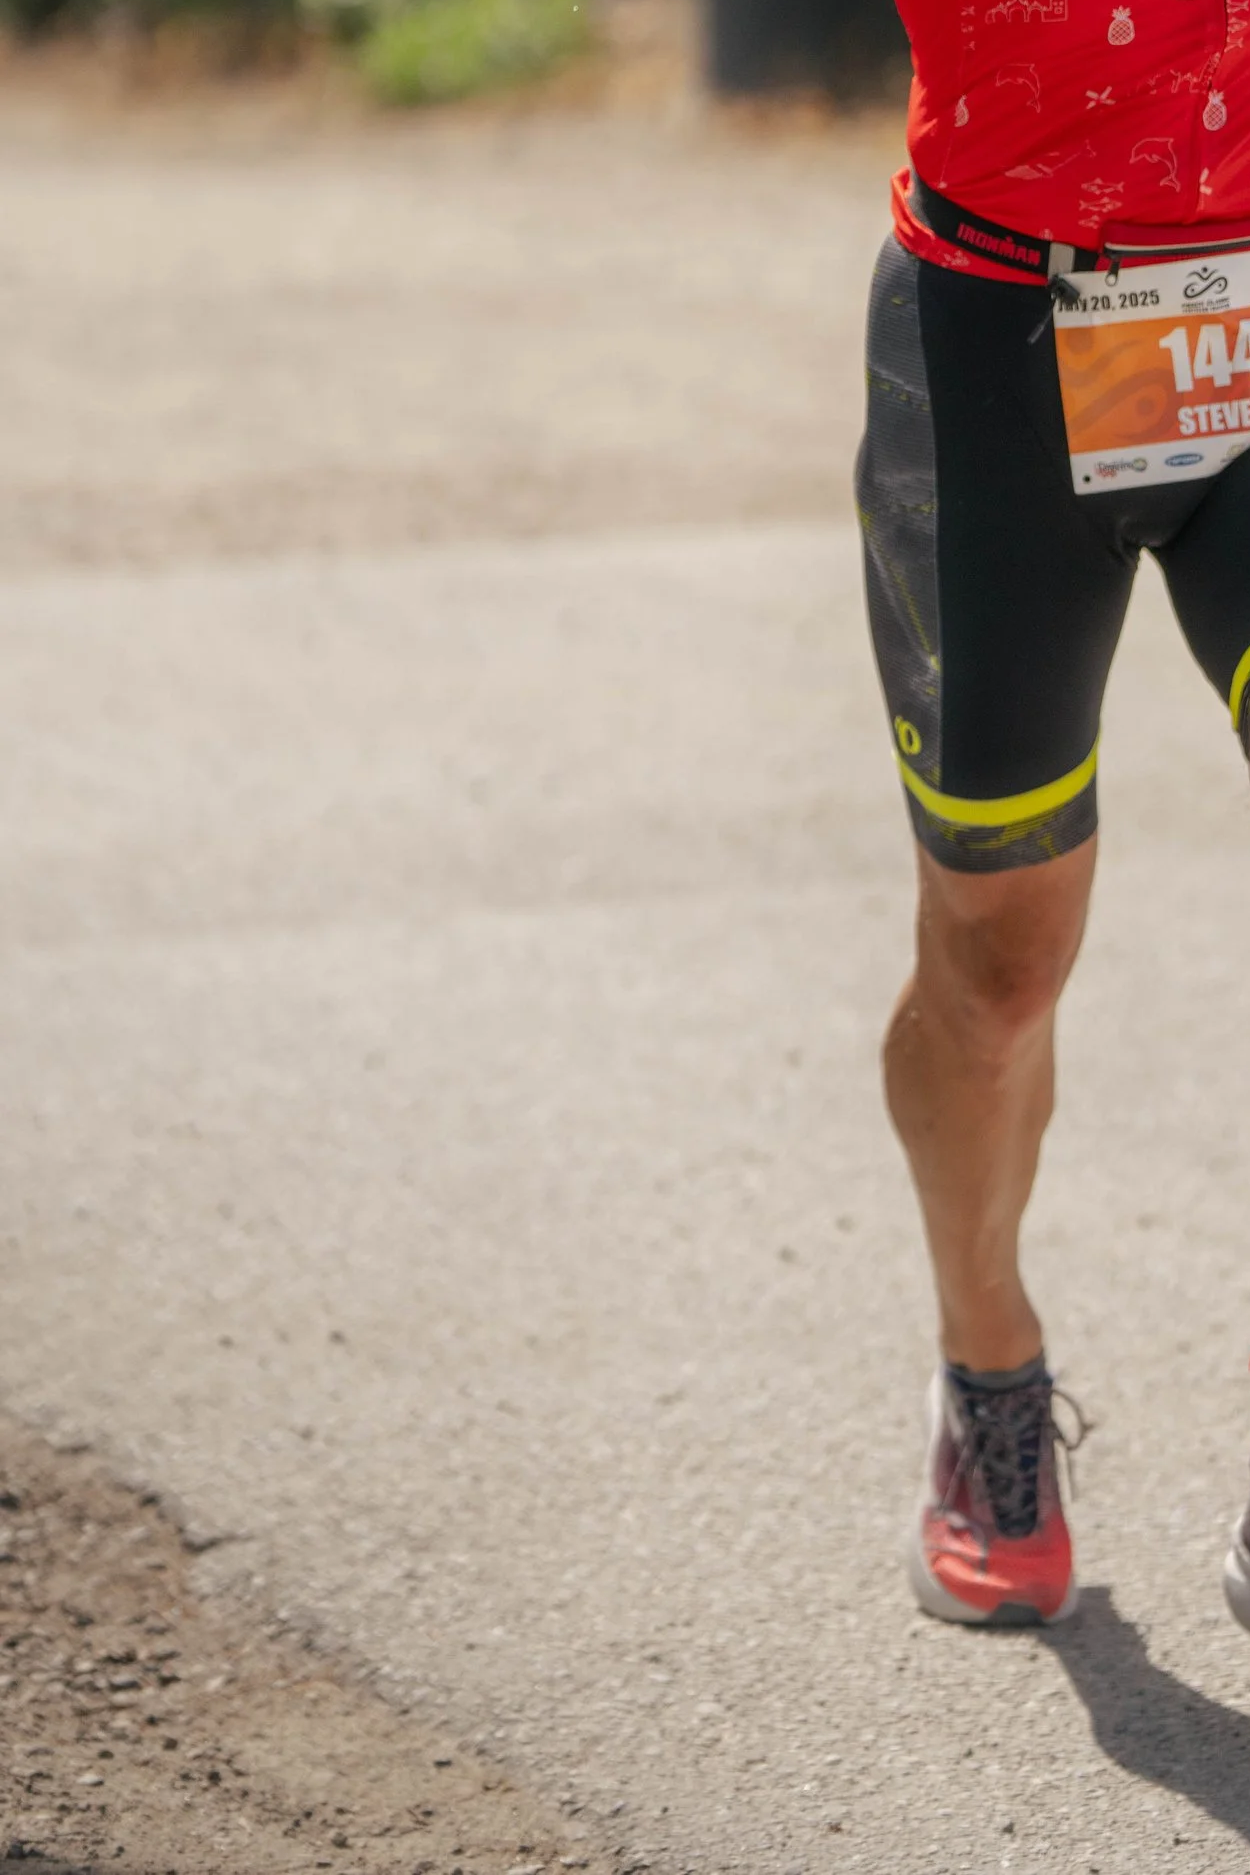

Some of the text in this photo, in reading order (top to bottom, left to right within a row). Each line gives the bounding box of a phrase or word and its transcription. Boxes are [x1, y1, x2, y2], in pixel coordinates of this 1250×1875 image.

[957, 222, 1041, 267] IRONMAN
[1090, 294, 1115, 312] 20,
[1118, 289, 1160, 310] 2025
